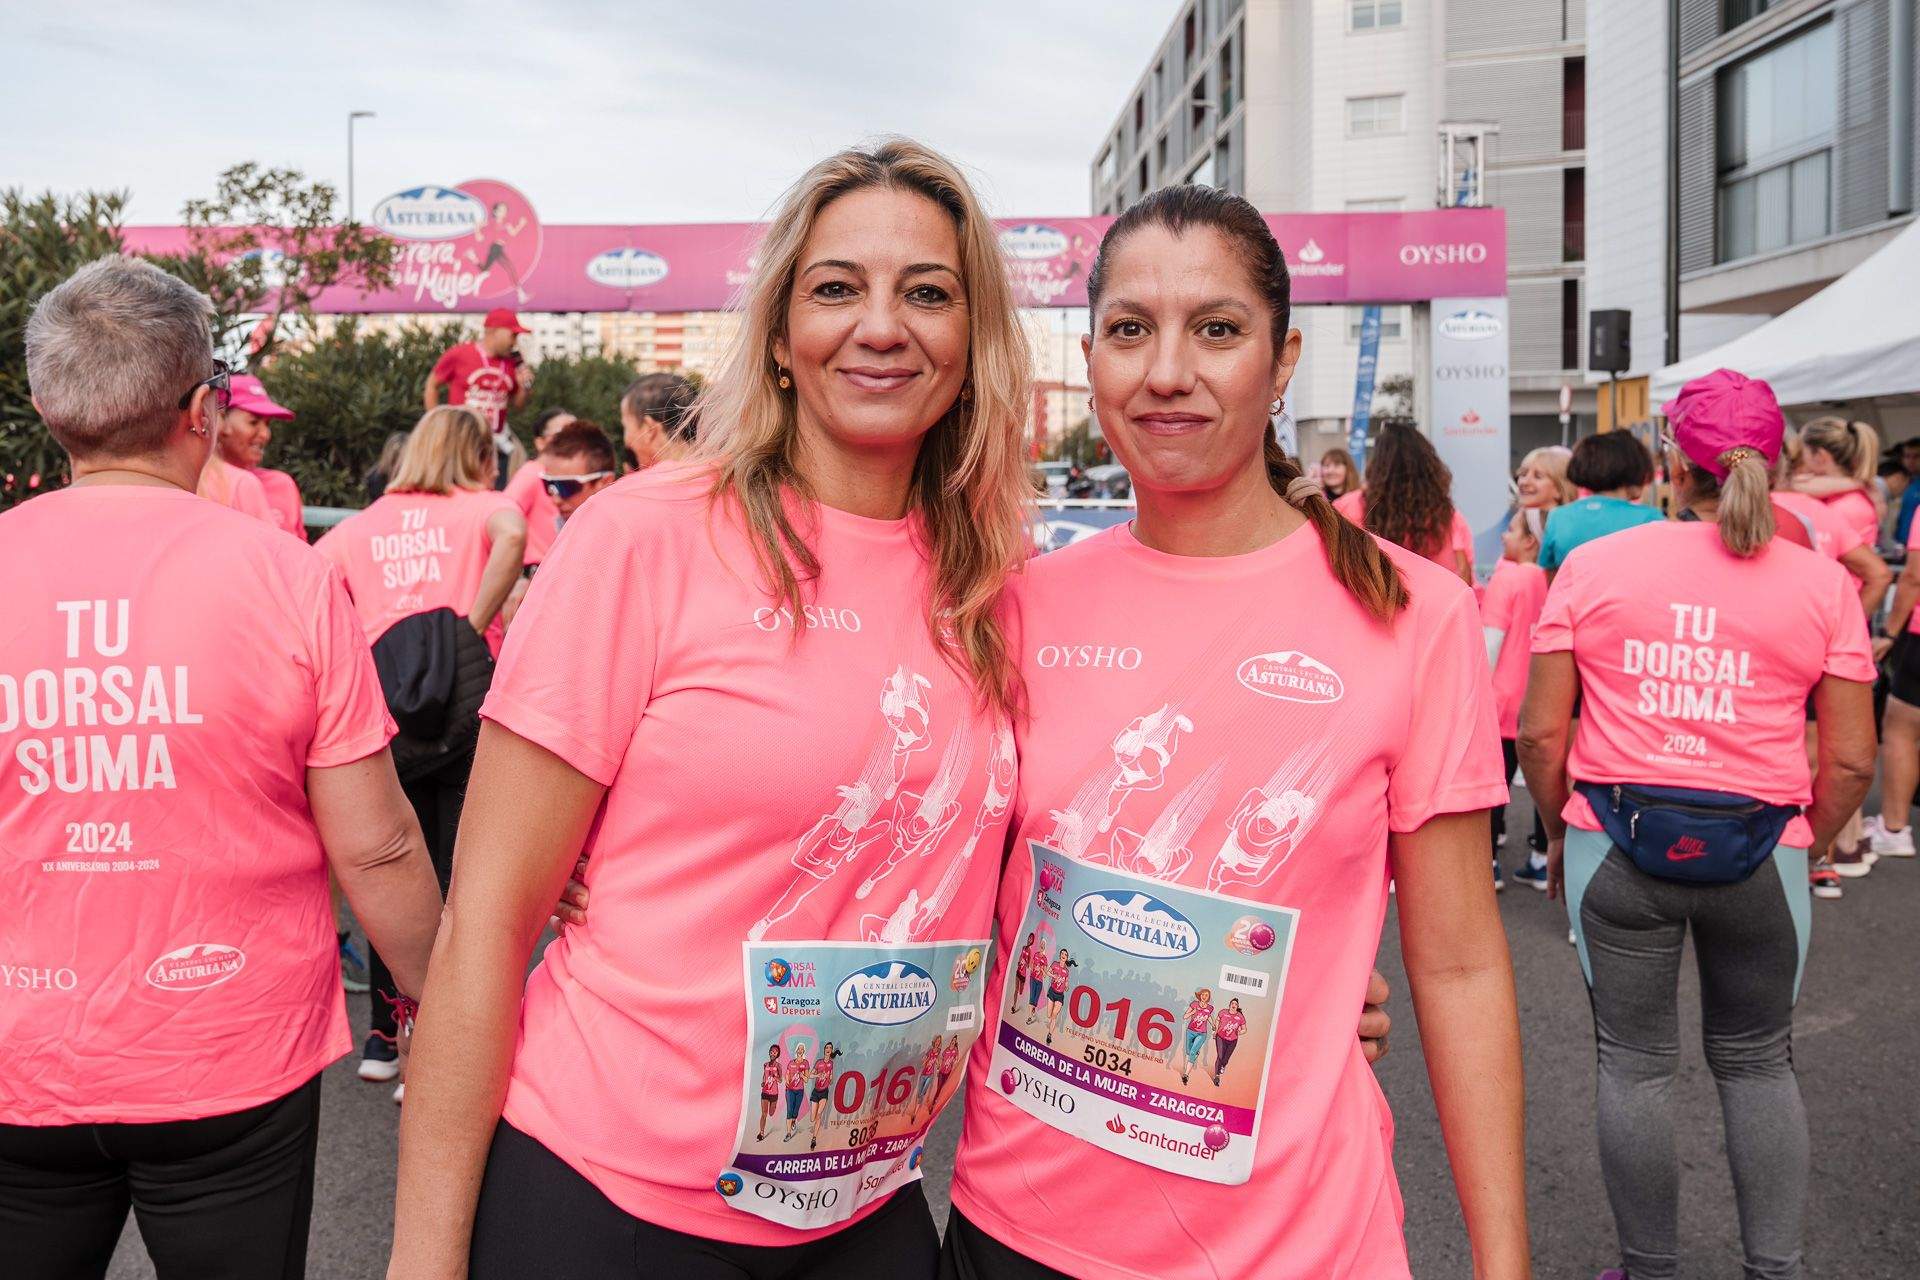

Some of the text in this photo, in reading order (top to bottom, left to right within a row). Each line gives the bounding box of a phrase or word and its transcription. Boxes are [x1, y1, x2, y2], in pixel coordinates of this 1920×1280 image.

[384, 206, 476, 225] ASTURIANA
[1400, 242, 1487, 265] OYSHO
[1286, 263, 1345, 277] antander
[1436, 364, 1505, 381] OYSHO
[402, 508, 428, 531] TU
[370, 527, 452, 562] DORSAL
[383, 556, 441, 589] SUMA
[56, 599, 129, 658] TU
[1670, 603, 1717, 642] TU
[1036, 645, 1142, 670] OYSHO
[1623, 638, 1755, 688] DORSAL
[1244, 663, 1336, 698] ASTURIANA
[1638, 679, 1737, 724] SUMA
[1662, 734, 1707, 756] 2024
[15, 734, 177, 795] SUMA
[65, 822, 133, 853] 2024
[42, 859, 160, 873] XX ANIVERSARIO 2004-2024
[1079, 902, 1188, 952] ASTURIANA
[1100, 904, 1188, 933] CENTRAL LECHERA
[0, 964, 78, 991] YSHO
[154, 959, 239, 984] ASTURIANA
[900, 981, 930, 989] LECHERA
[781, 996, 821, 1008] Zaragoza
[844, 983, 930, 1009] ASTURIANA
[782, 1006, 821, 1016] DEPORTE
[1068, 985, 1176, 1051] 016
[1083, 1044, 1132, 1076] 5034
[833, 1065, 916, 1114] 016
[1014, 1036, 1225, 1124] CARRERA DE LA MUJER ZARAGOZA
[1128, 1122, 1218, 1160] Santander
[765, 1157, 821, 1174] CARRERA
[825, 1155, 839, 1171] DE
[841, 1154, 854, 1169] LA
[754, 1182, 838, 1211] OYSHO
